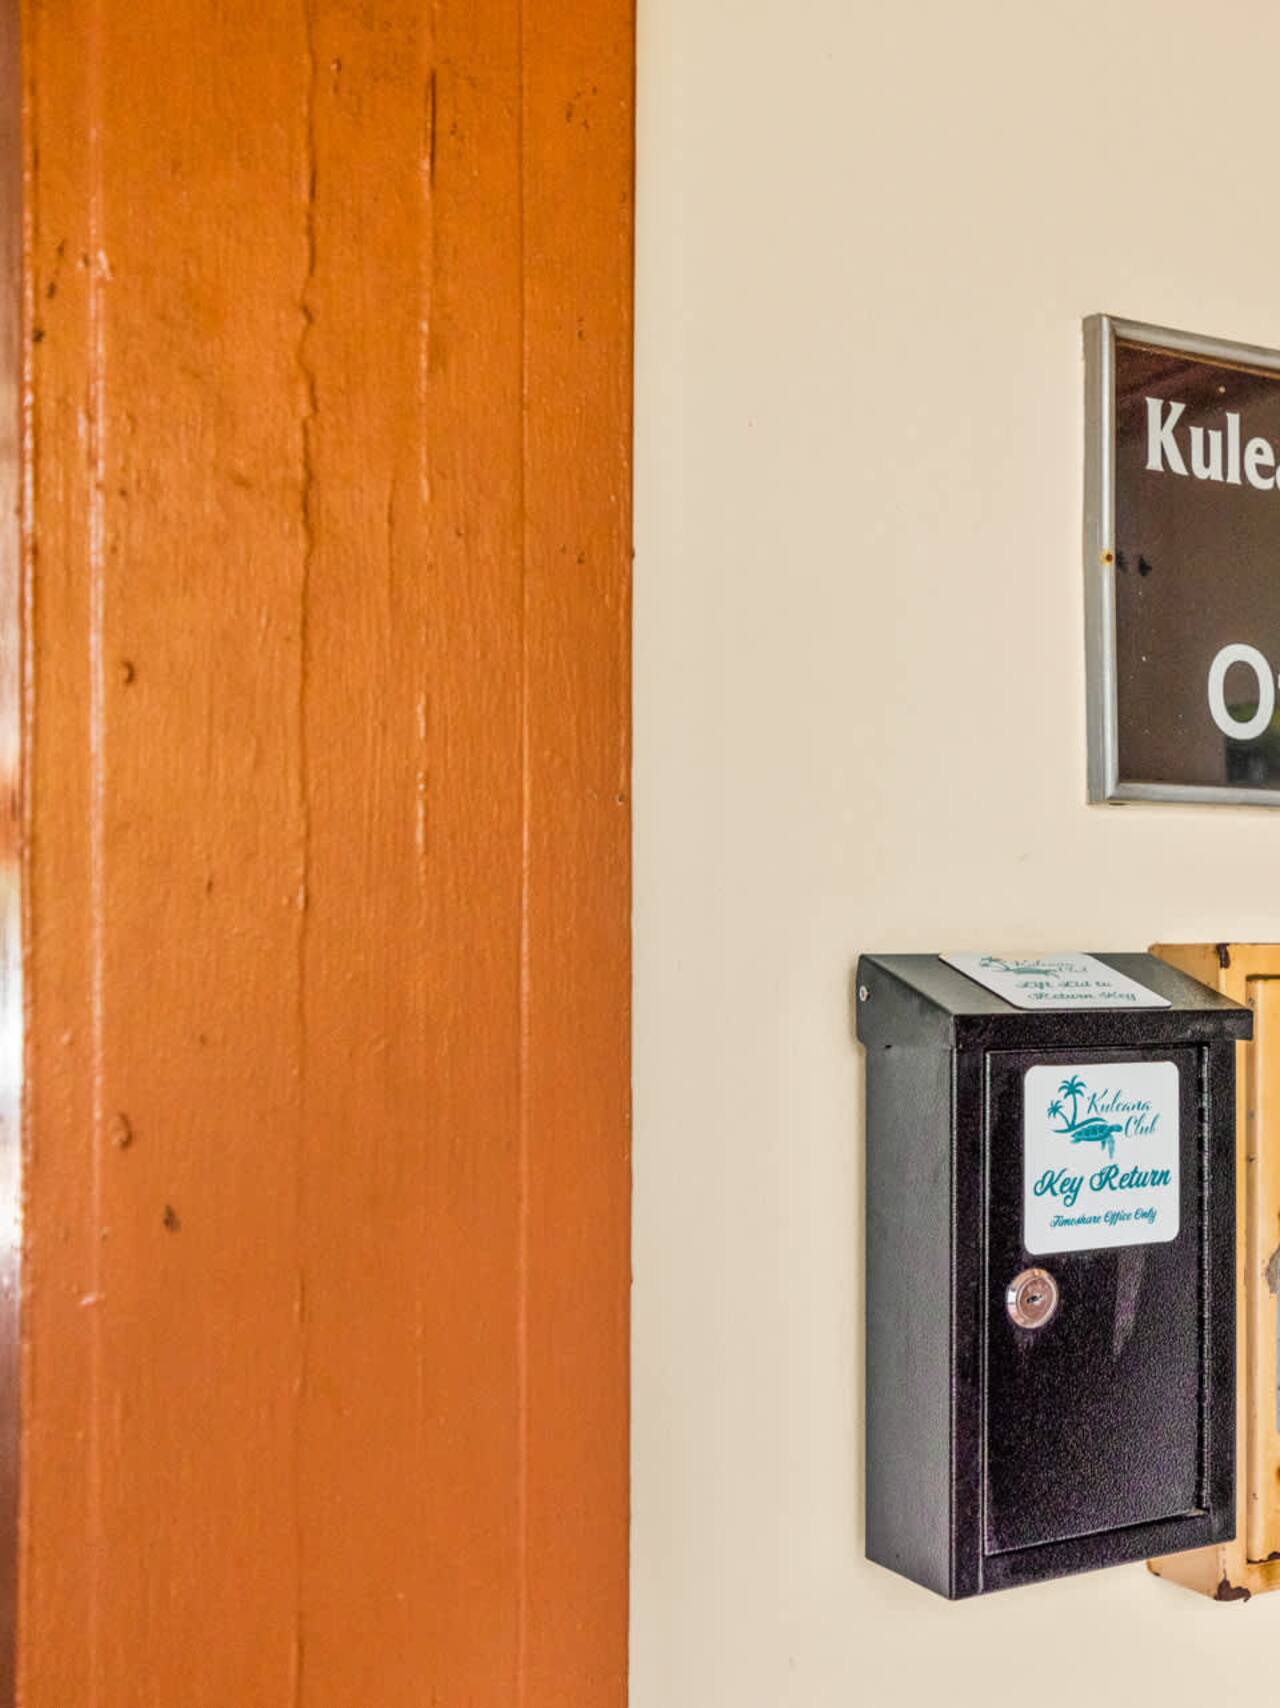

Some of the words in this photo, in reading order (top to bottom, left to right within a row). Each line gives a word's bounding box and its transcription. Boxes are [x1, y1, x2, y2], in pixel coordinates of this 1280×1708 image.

[1028, 992, 1095, 1000] Return
[1096, 992, 1137, 1001] Key
[1087, 1088, 1152, 1115] Kuleana
[1124, 1113, 1160, 1137] Club
[1032, 1167, 1085, 1209] Key
[1089, 1163, 1172, 1193] Return
[1050, 1213, 1101, 1229] Timeshare
[1103, 1209, 1133, 1227] Office
[1133, 1206, 1158, 1225] Only
